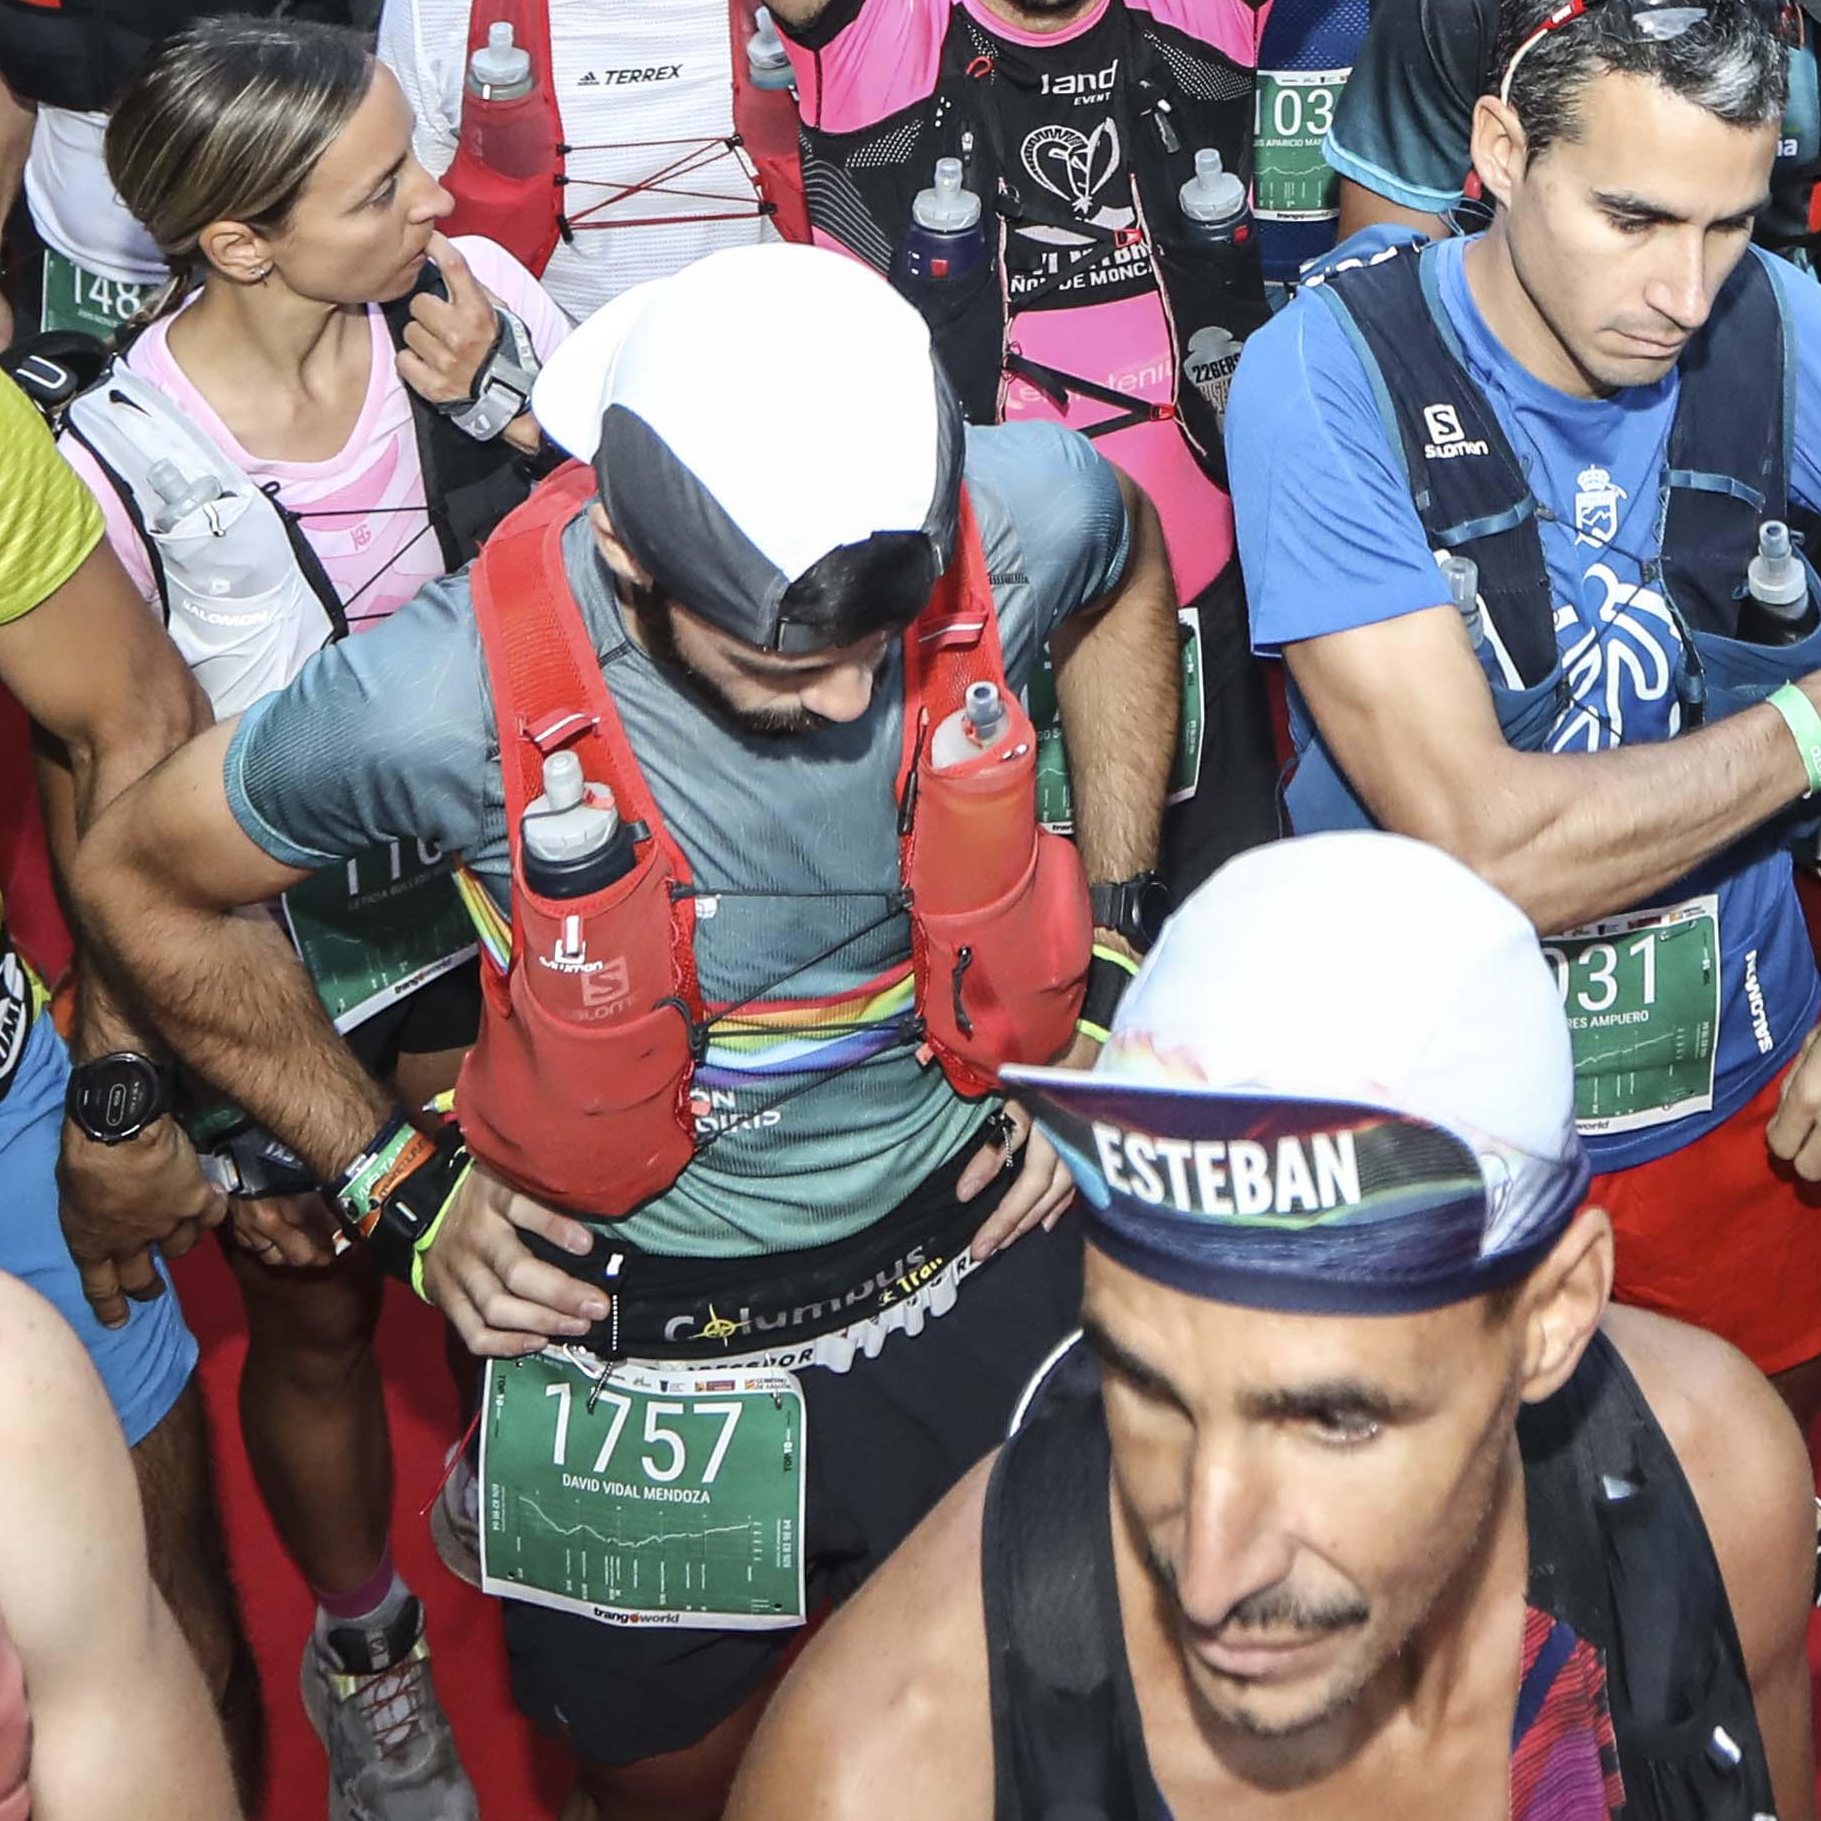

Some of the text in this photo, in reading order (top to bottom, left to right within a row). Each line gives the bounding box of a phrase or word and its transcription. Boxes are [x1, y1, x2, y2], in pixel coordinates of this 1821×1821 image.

[604, 63, 682, 85] TERREX
[1590, 1009, 1649, 1028] AMPUERO
[1096, 1122, 1361, 1217] ESTEBAN
[544, 1382, 743, 1483] 1757
[562, 1472, 710, 1505] DAVID VIDAL MENDOZA
